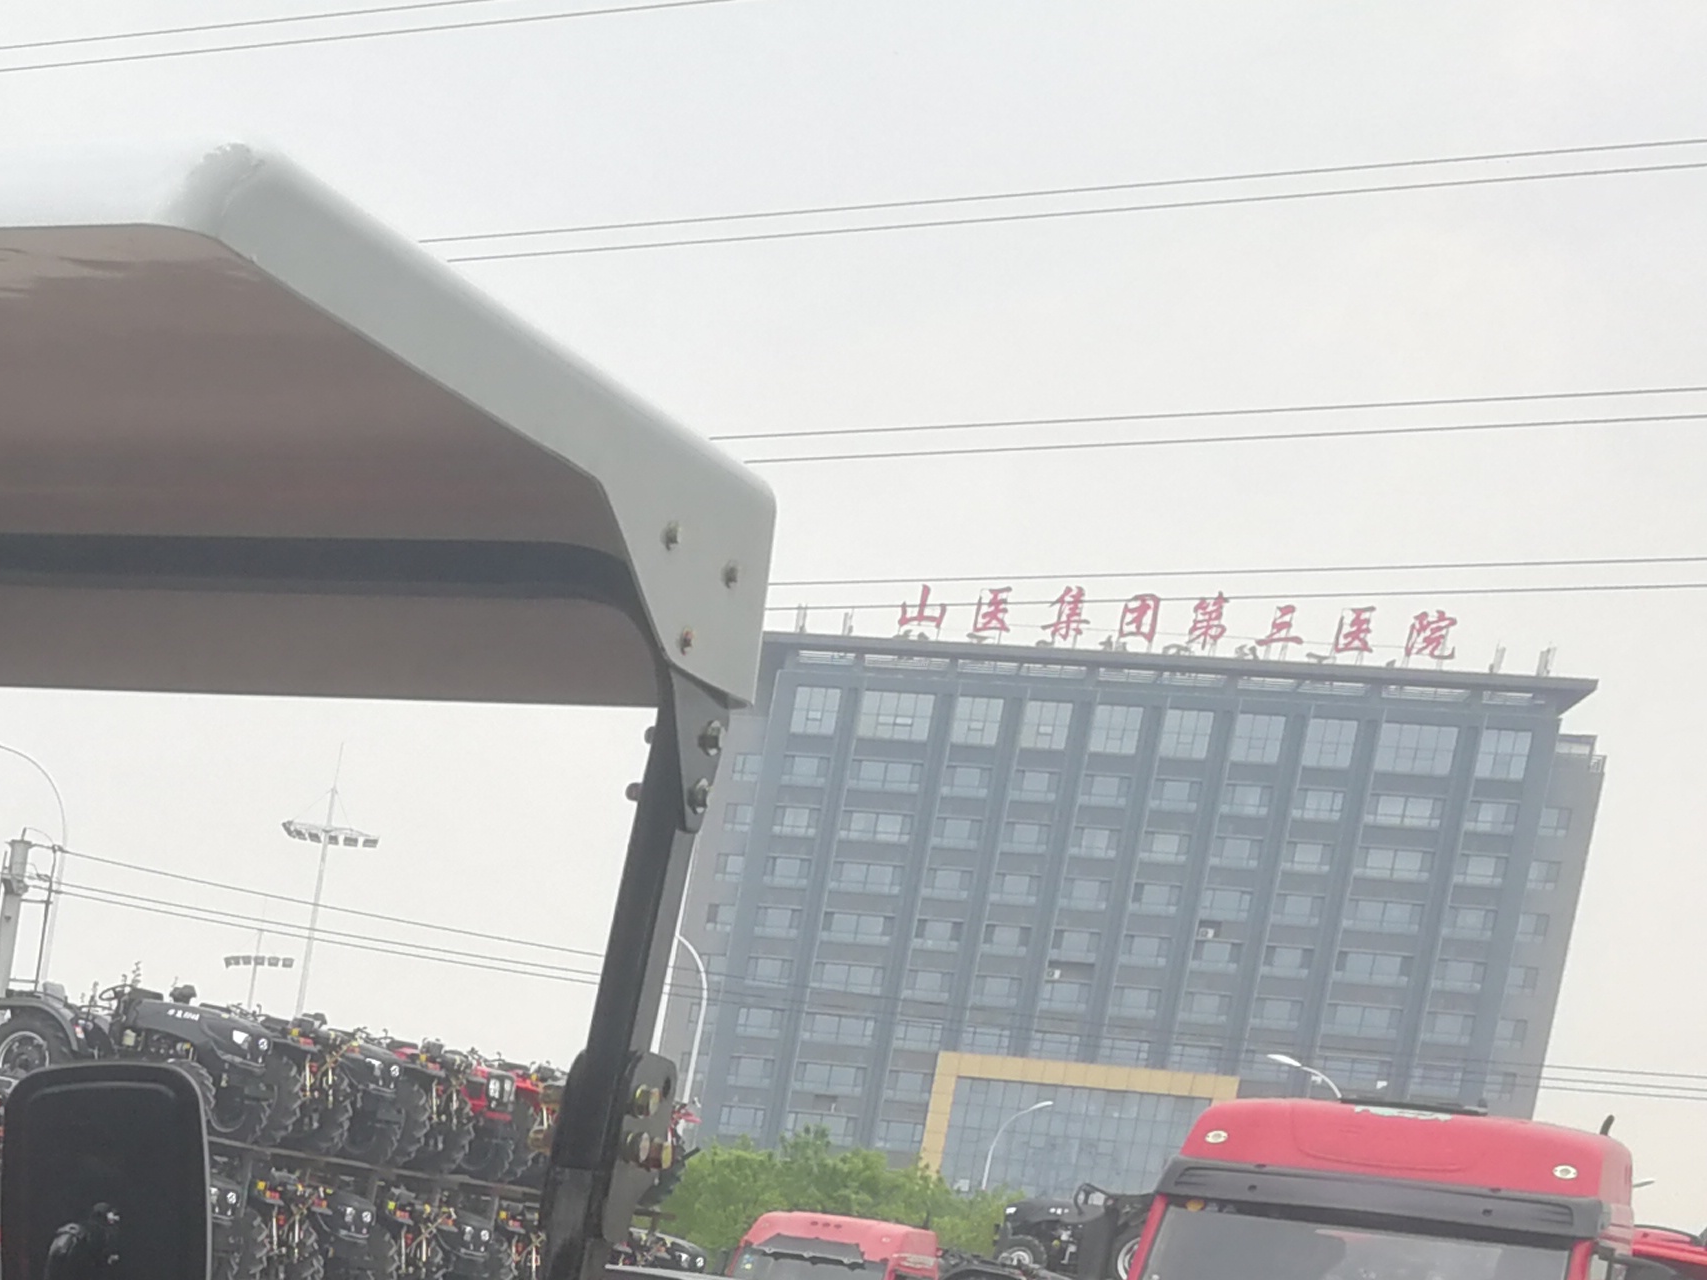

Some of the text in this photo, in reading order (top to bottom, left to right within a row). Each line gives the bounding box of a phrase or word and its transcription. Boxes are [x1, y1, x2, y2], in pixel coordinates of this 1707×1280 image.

[898, 584, 1458, 660] 山医集团第三医院
